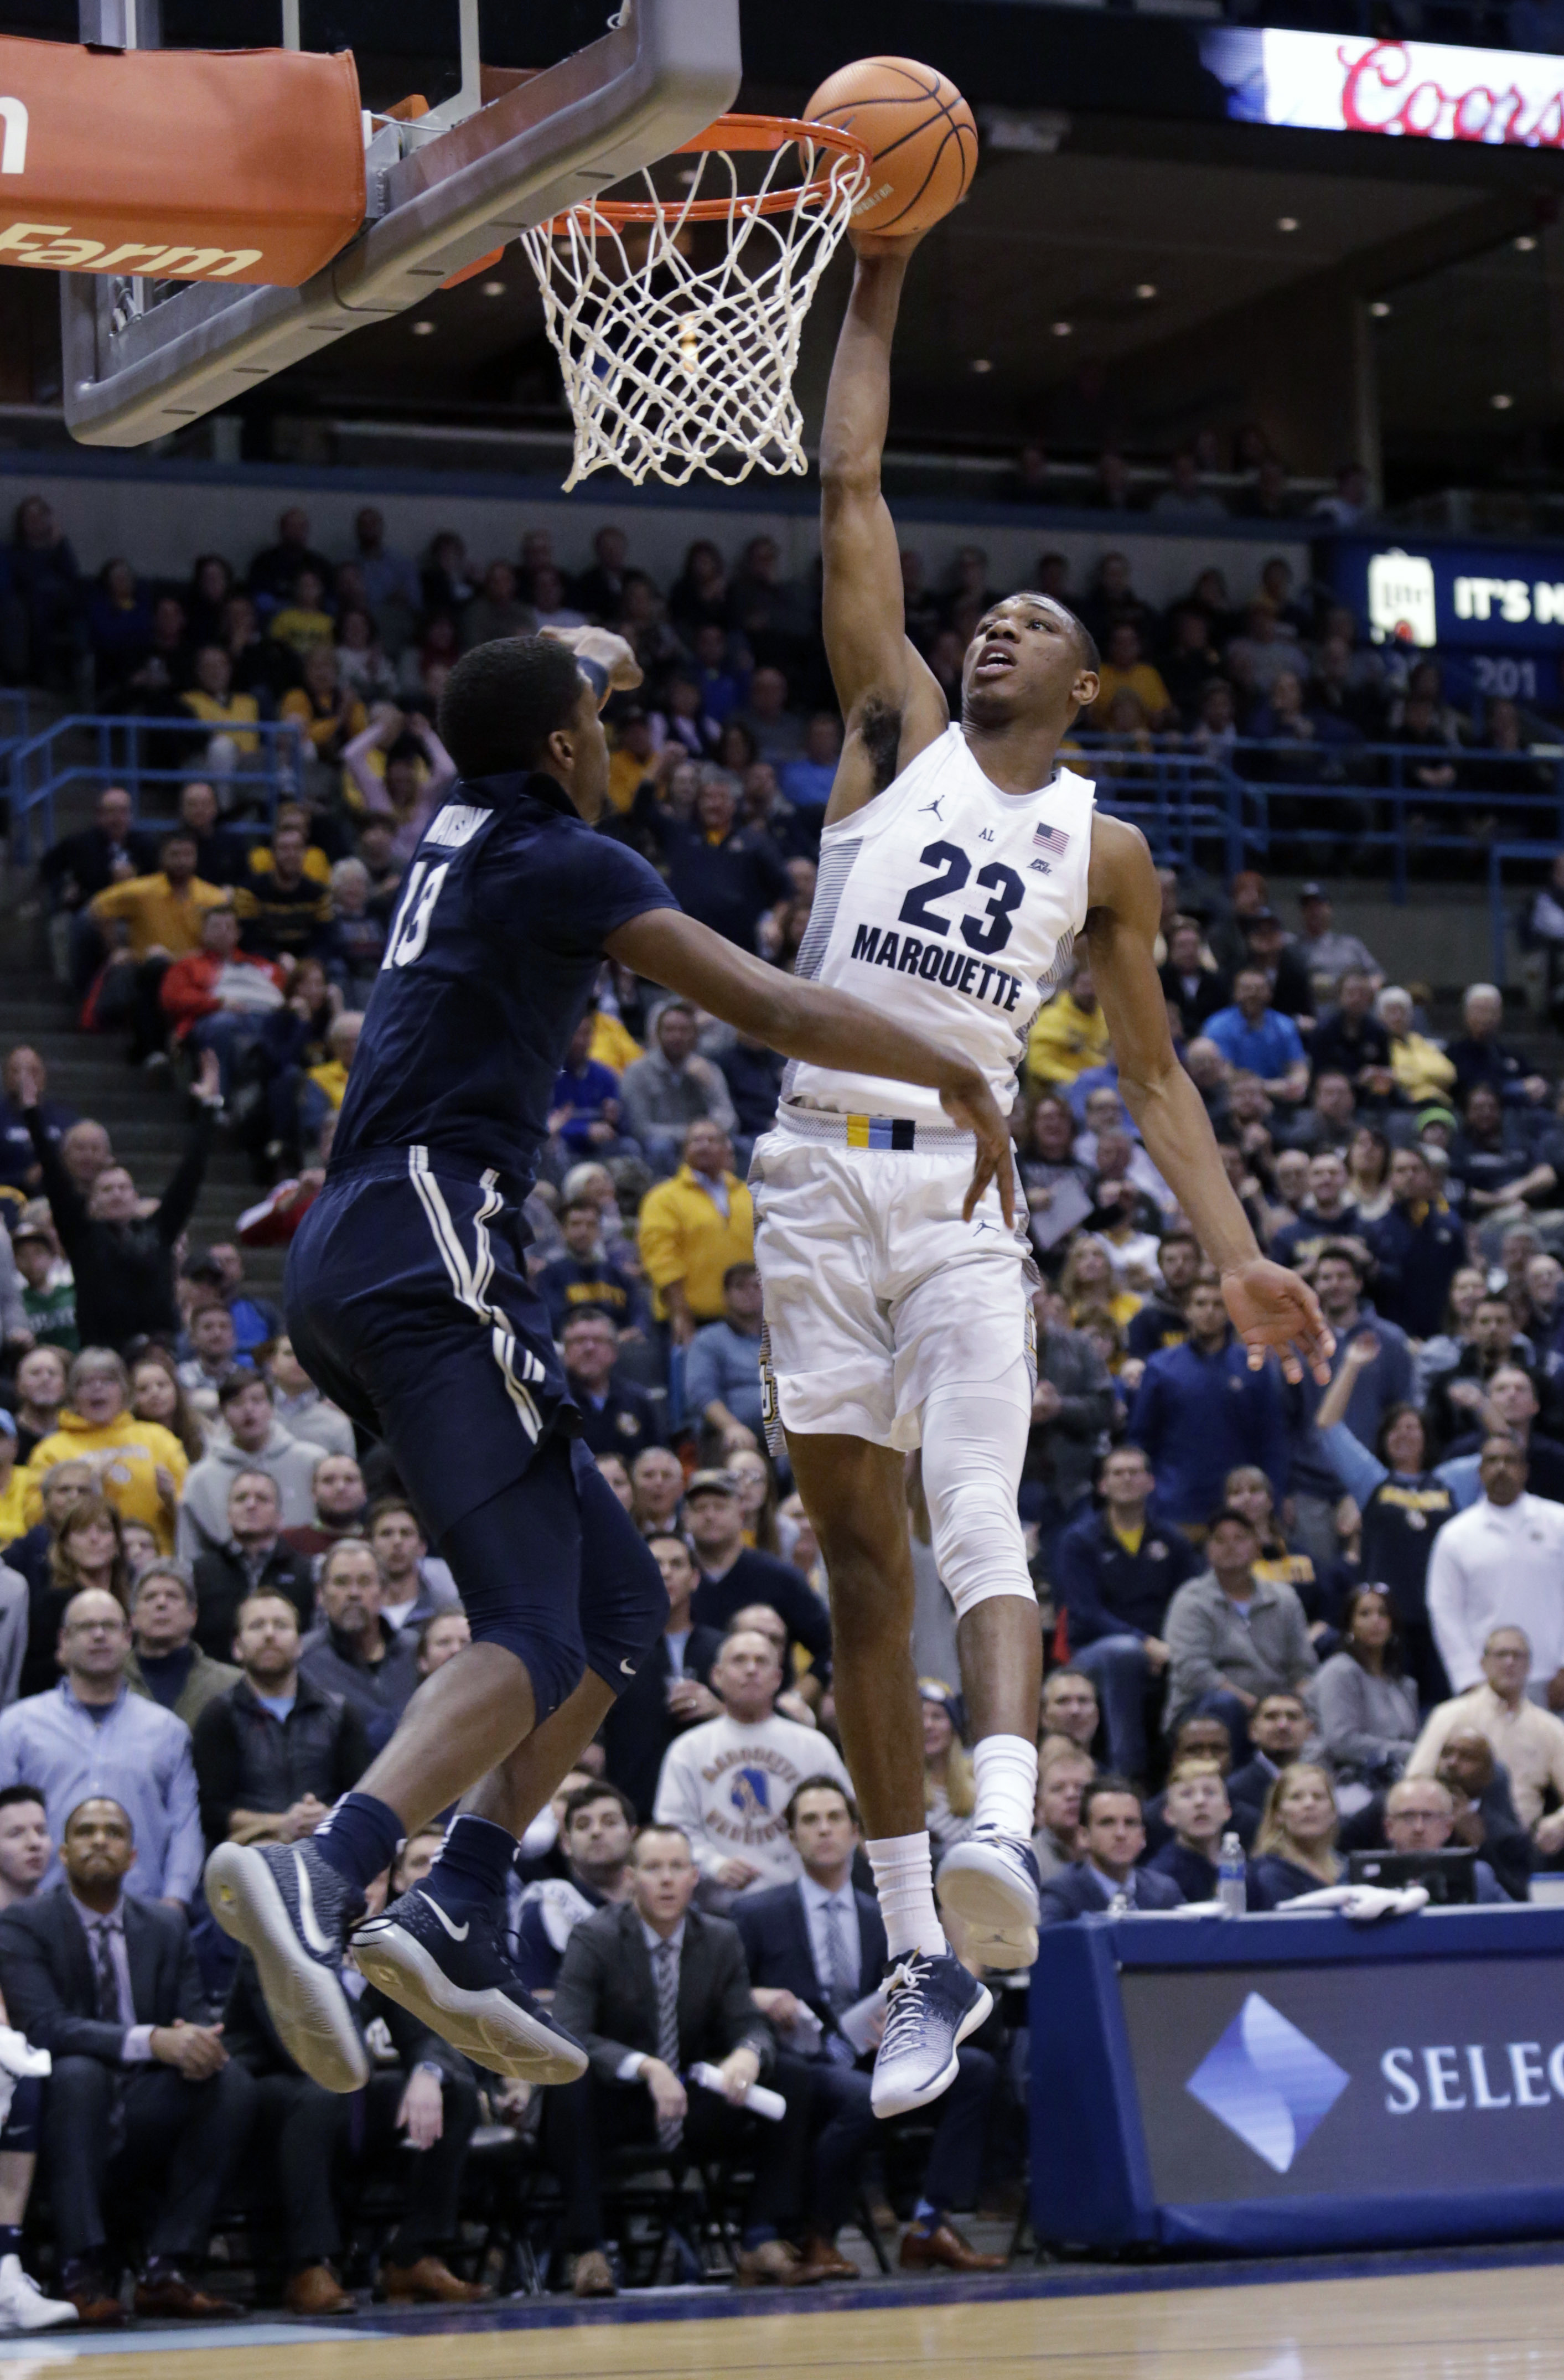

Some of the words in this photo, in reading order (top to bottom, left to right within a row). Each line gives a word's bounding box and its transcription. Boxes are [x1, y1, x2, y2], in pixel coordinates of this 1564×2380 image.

[0, 223, 263, 276] Farm
[1454, 576, 1531, 623] IT'S
[978, 827, 995, 842] AL
[1028, 864, 1053, 875] EAST
[1030, 858, 1051, 868] BIG
[381, 862, 450, 970] 13
[898, 840, 1026, 955] 23
[851, 924, 1023, 1012] MARQUETTE
